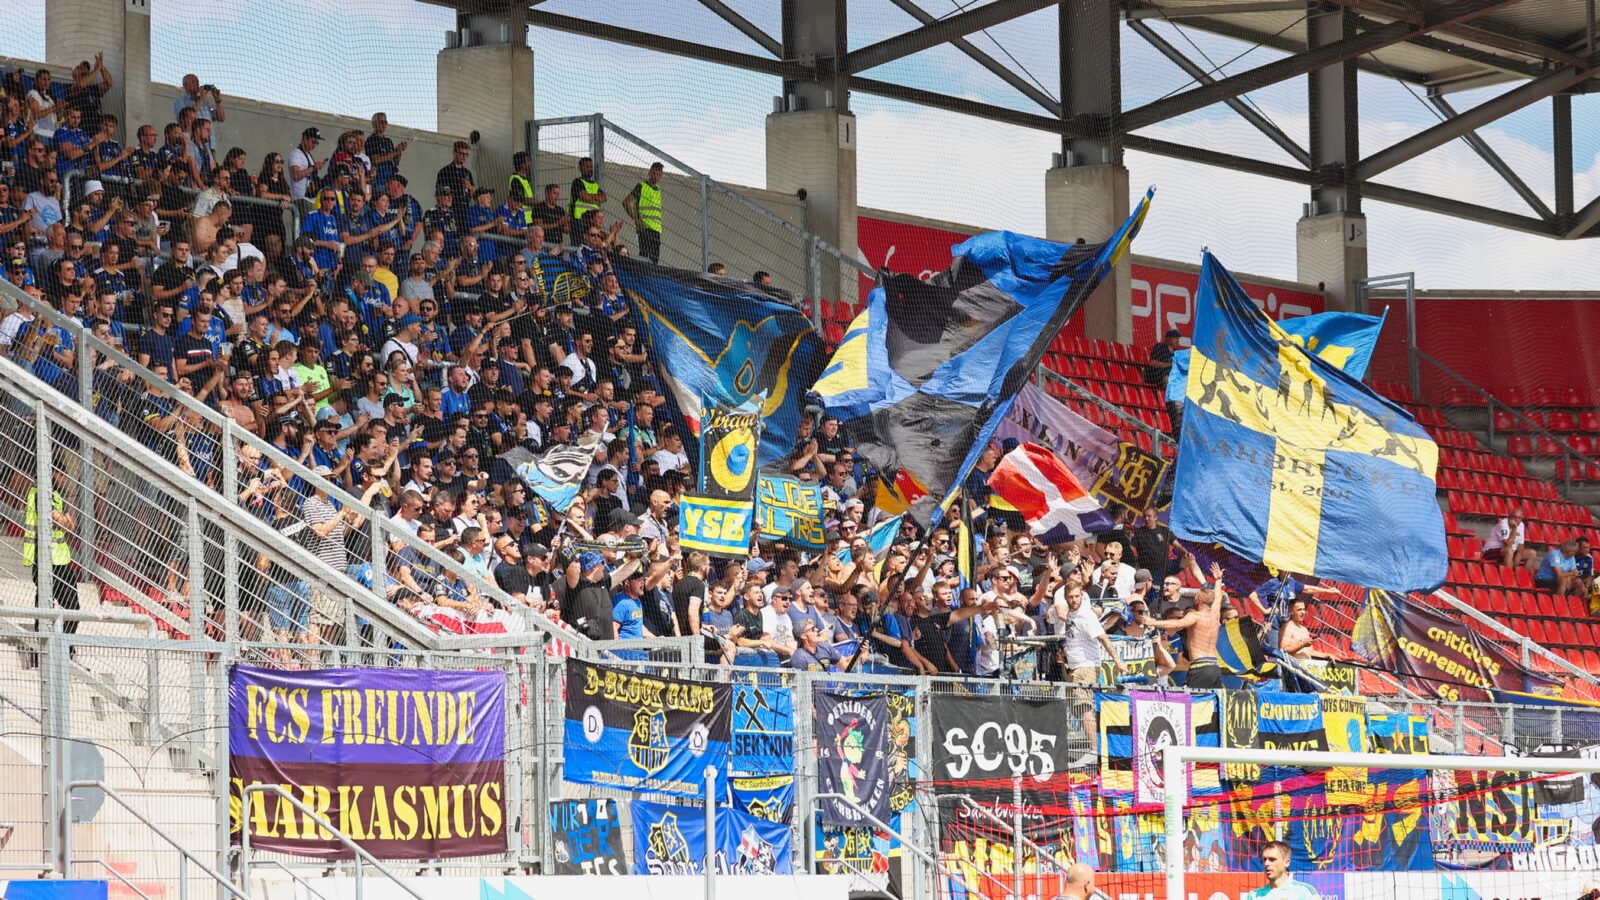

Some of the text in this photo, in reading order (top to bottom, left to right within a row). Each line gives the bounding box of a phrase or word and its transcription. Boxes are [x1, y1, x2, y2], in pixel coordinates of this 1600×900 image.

[701, 408, 756, 434] Virage
[684, 508, 746, 542] YSB
[1427, 626, 1501, 676] critiques
[584, 666, 714, 713] D-BLOCK GANG
[1437, 684, 1460, 702] 66
[245, 684, 476, 746] FCS FREUNDE
[735, 735, 794, 758] SEKTION
[943, 722, 1057, 782] SC95
[229, 776, 502, 841] SAARKASMUS
